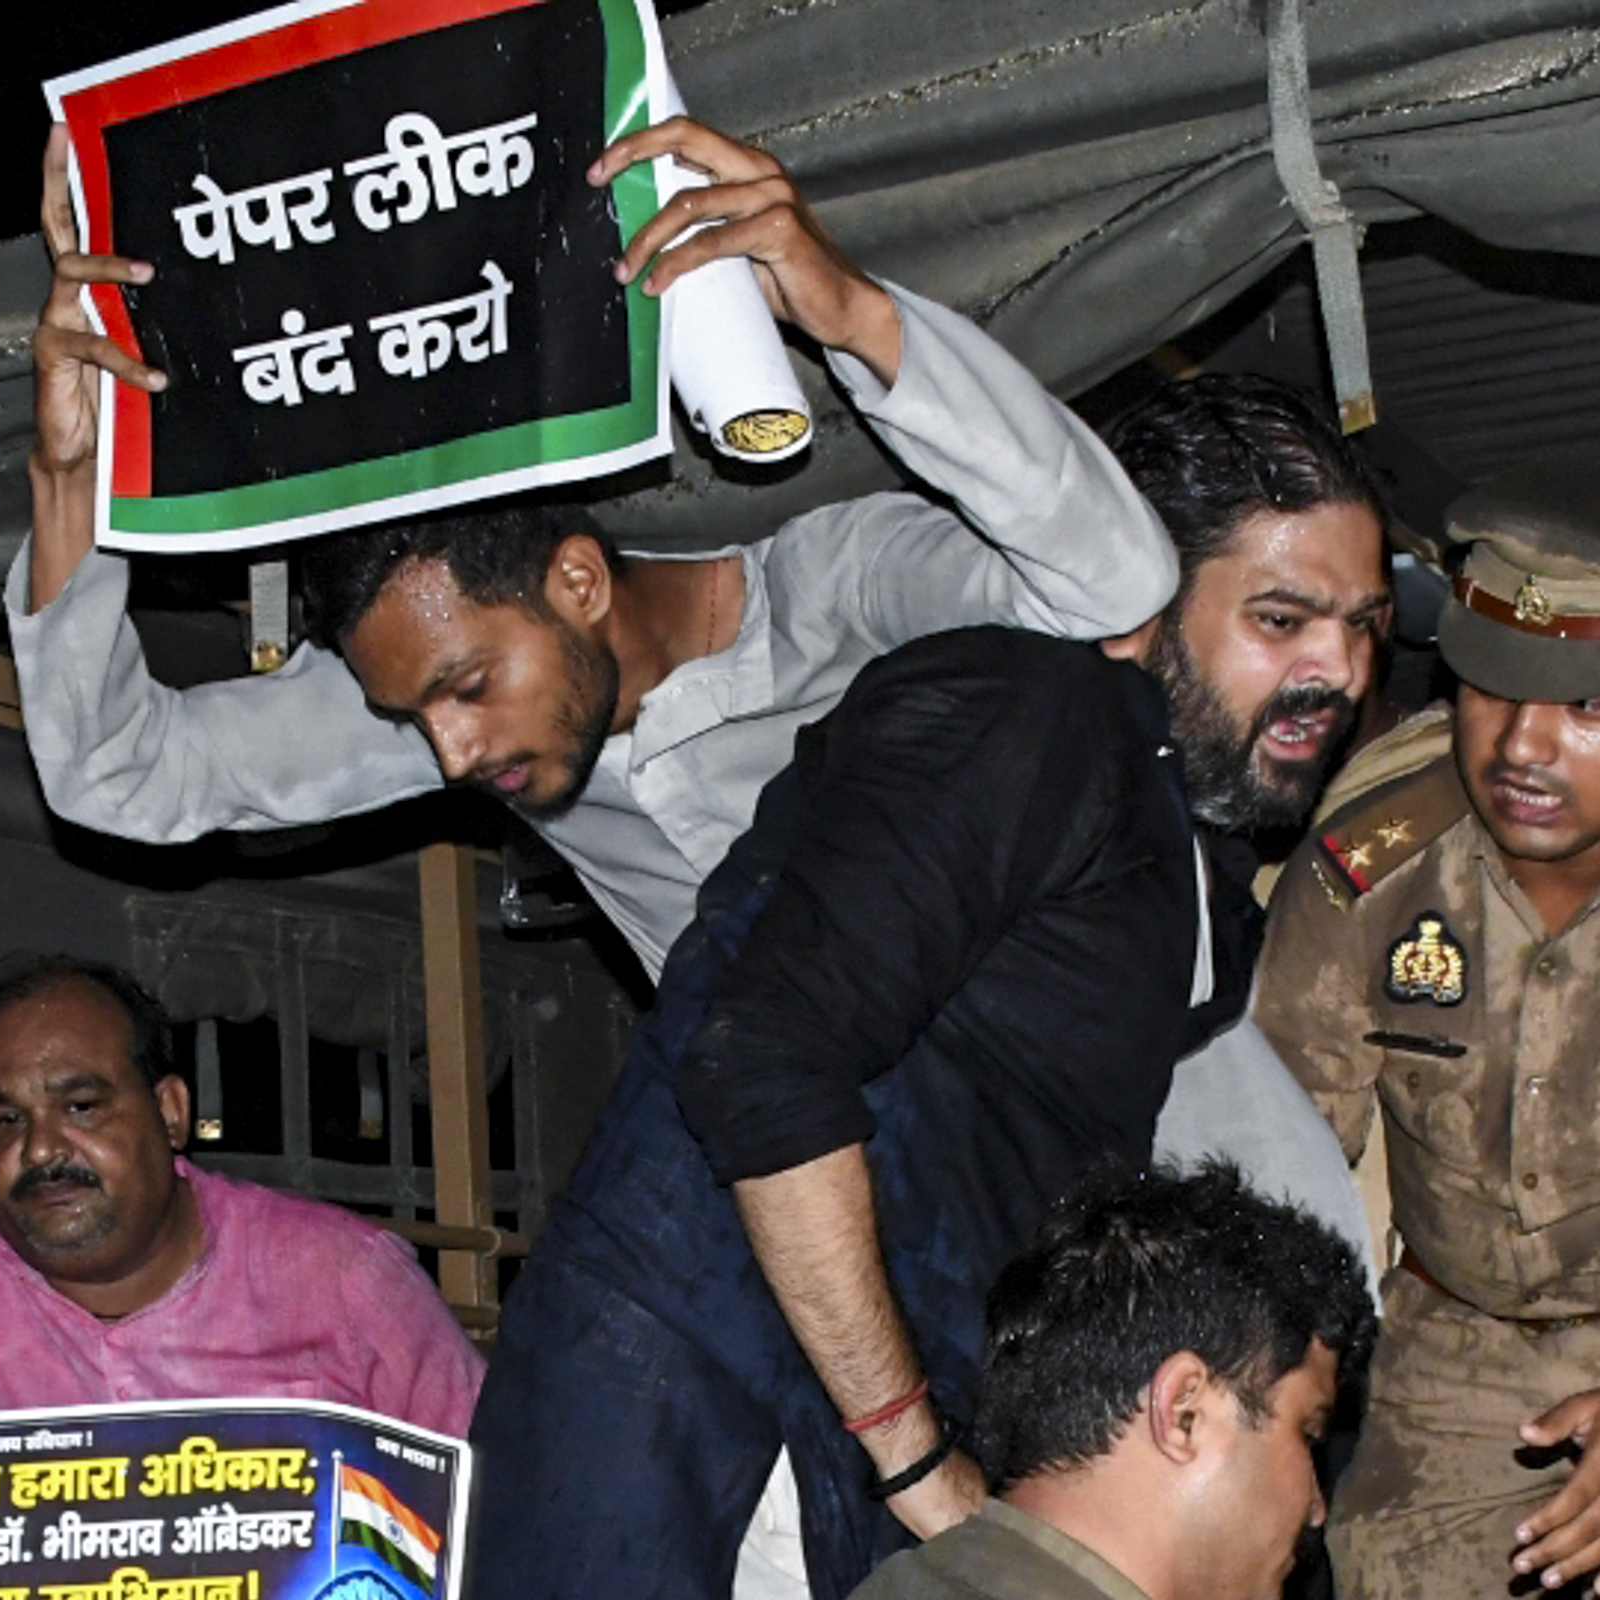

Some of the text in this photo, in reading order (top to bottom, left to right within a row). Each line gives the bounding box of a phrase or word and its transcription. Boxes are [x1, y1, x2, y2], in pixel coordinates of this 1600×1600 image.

[172, 112, 538, 264] पेपर लीक
[232, 260, 514, 406] बंद करो
[11, 1457, 128, 1507] हमारा
[140, 1437, 318, 1497] अधिकार;
[43, 1511, 163, 1561] भीमराव
